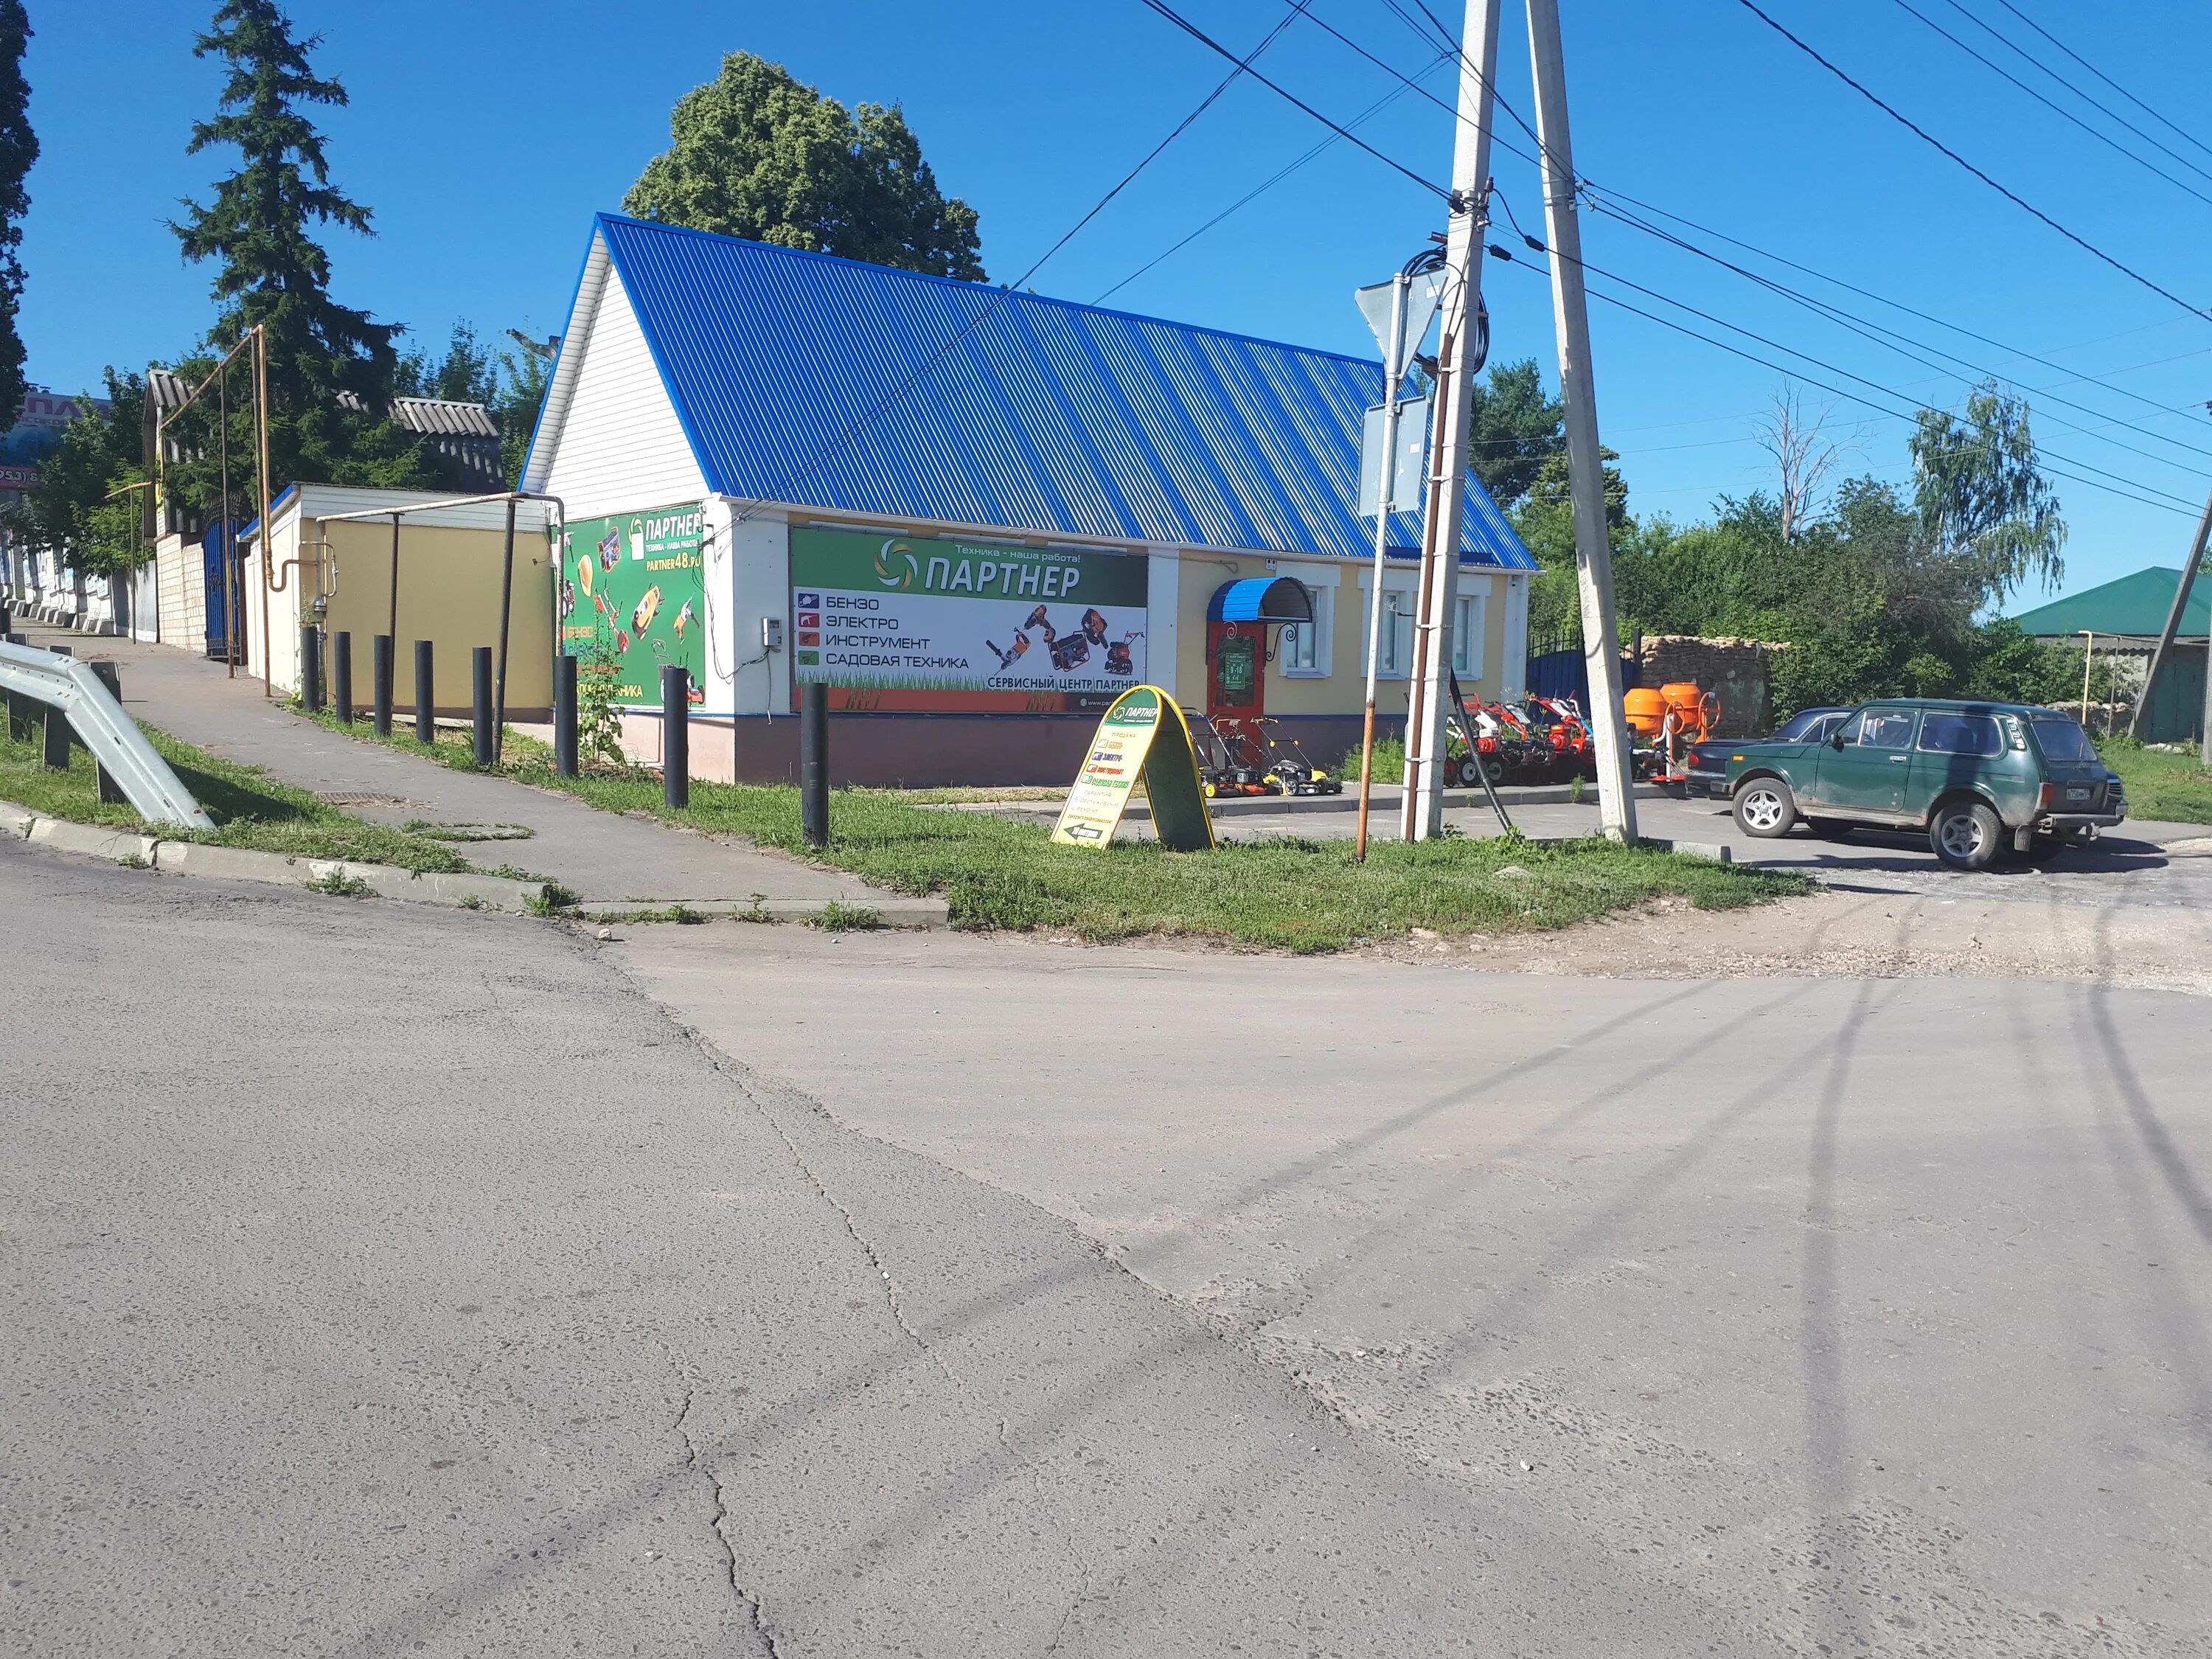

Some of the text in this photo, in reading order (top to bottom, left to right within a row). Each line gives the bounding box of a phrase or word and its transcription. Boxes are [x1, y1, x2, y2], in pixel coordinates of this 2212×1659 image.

[646, 512, 701, 540] ПАРТНЕР
[646, 552, 701, 571] PARTNER48.RU
[956, 544, 1000, 557] Техника
[1010, 551, 1039, 560] наша
[1041, 554, 1081, 563] работа!
[925, 557, 1081, 597] ПАРТНЕР
[826, 597, 880, 611] БЕНЗО
[826, 616, 899, 630] ЭЛЕКТРО
[826, 634, 931, 650] ИНСТРУМЕНТ
[826, 653, 970, 669] САДОВАЯ ТЕХНИКА
[987, 675, 1055, 689] СЕРВИСНЫЙ
[1059, 678, 1093, 691] ЦЕНТР
[1124, 707, 1158, 717] ПАРТНЕР
